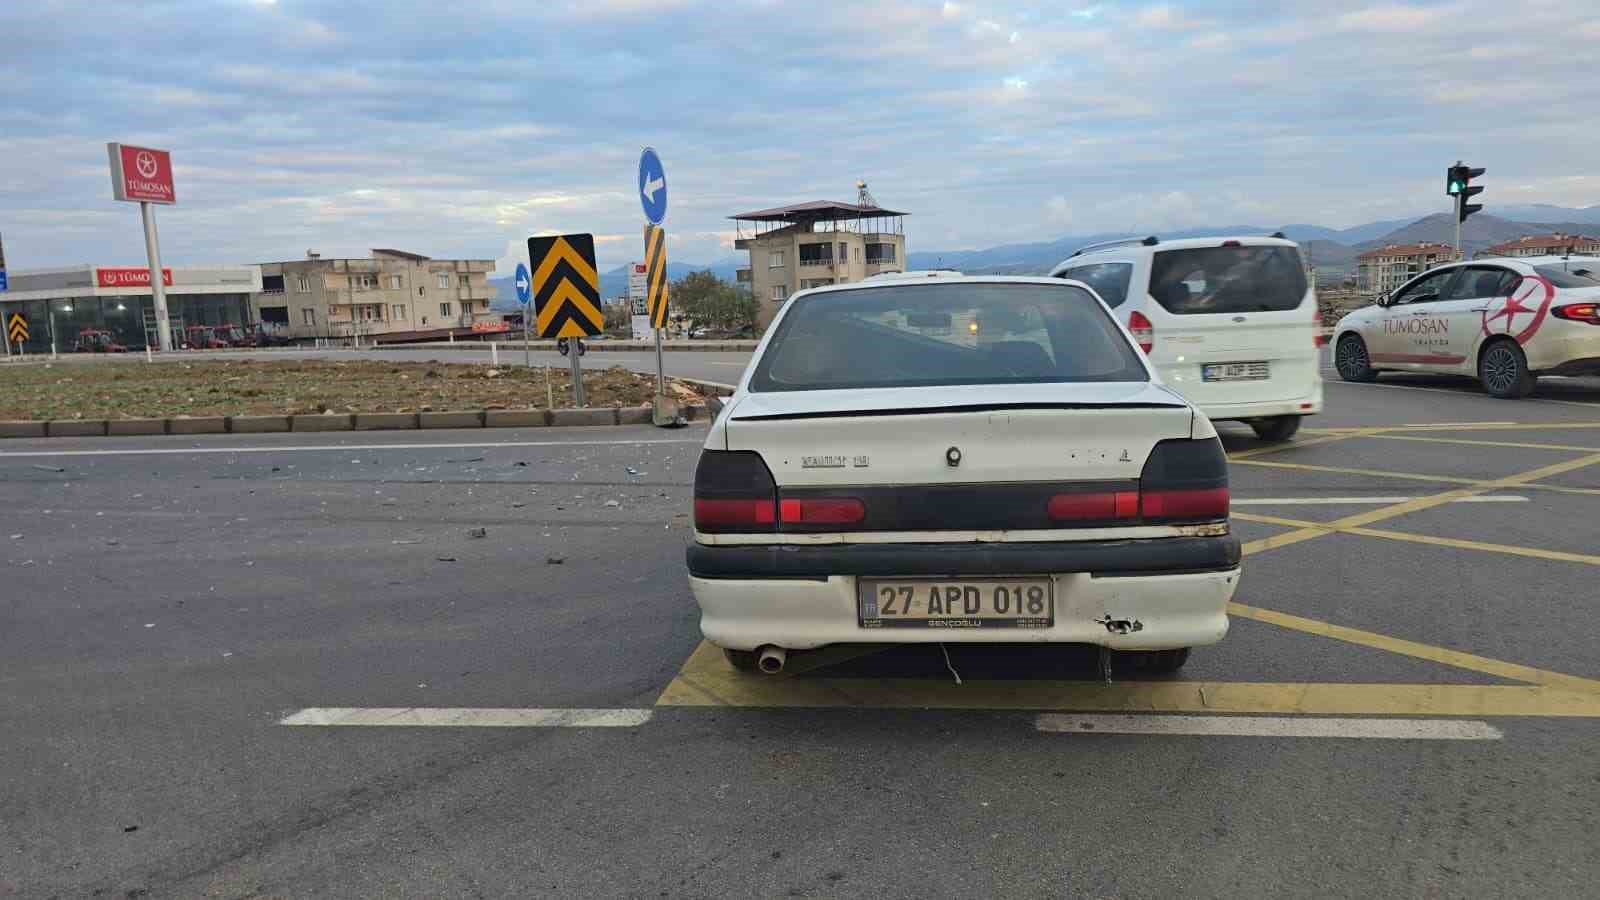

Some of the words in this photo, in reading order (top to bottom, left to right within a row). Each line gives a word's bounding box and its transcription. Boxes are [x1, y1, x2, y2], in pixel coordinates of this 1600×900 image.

[118, 271, 169, 282] TÜMON
[880, 586, 914, 615] 27
[927, 586, 981, 615] APD
[993, 586, 1044, 615] 018
